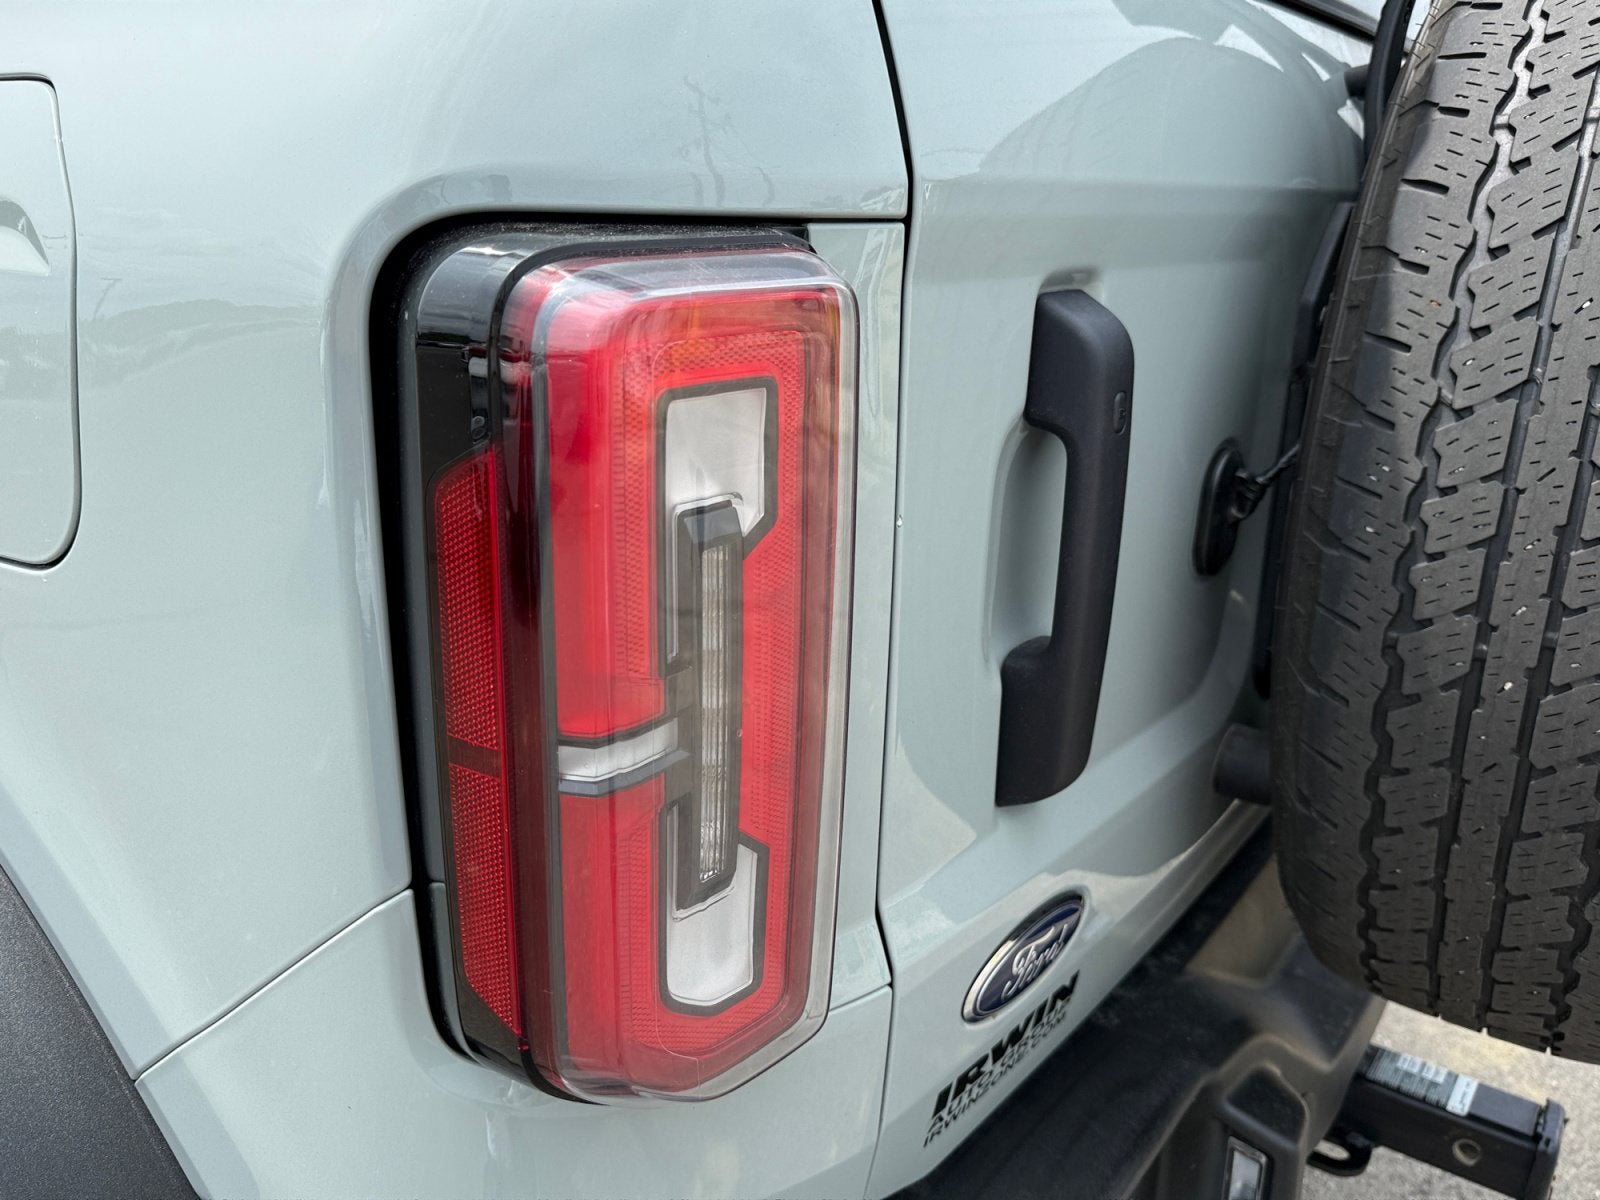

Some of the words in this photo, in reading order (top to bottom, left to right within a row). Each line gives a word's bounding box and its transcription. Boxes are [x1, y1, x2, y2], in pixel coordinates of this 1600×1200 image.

[1002, 923, 1069, 1001] Ford
[927, 1069, 993, 1135] AUTO
[1001, 996, 1071, 1068] GROUP
[931, 969, 1080, 1119] IRWIN
